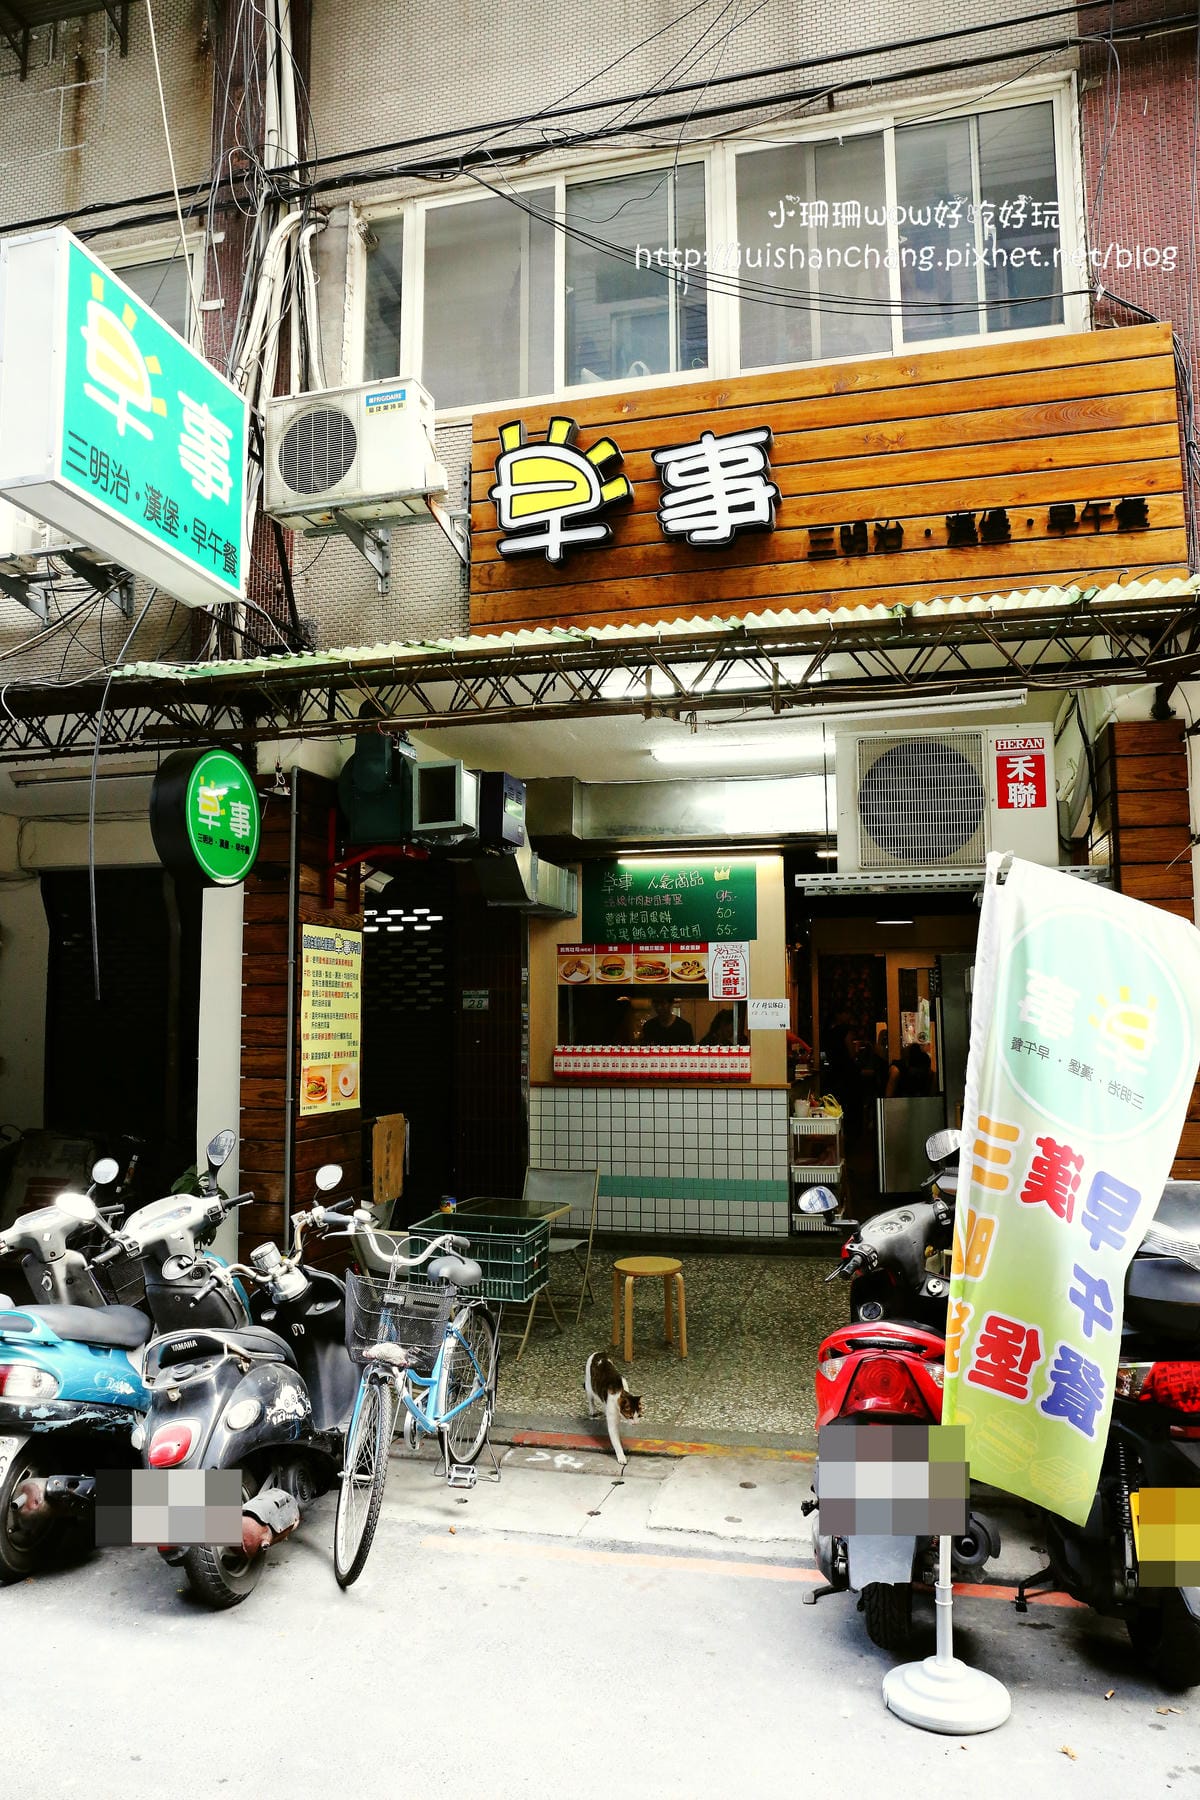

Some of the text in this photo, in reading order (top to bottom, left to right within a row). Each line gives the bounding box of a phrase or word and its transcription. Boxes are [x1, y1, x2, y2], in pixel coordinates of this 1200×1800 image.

[80, 273, 233, 505] 早事
[489, 418, 780, 564] 早事
[996, 738, 1043, 750] HERAN
[1006, 755, 1037, 808] 禾聯
[467, 999, 484, 1009] 28
[171, 1339, 198, 1352] YAMAHA
